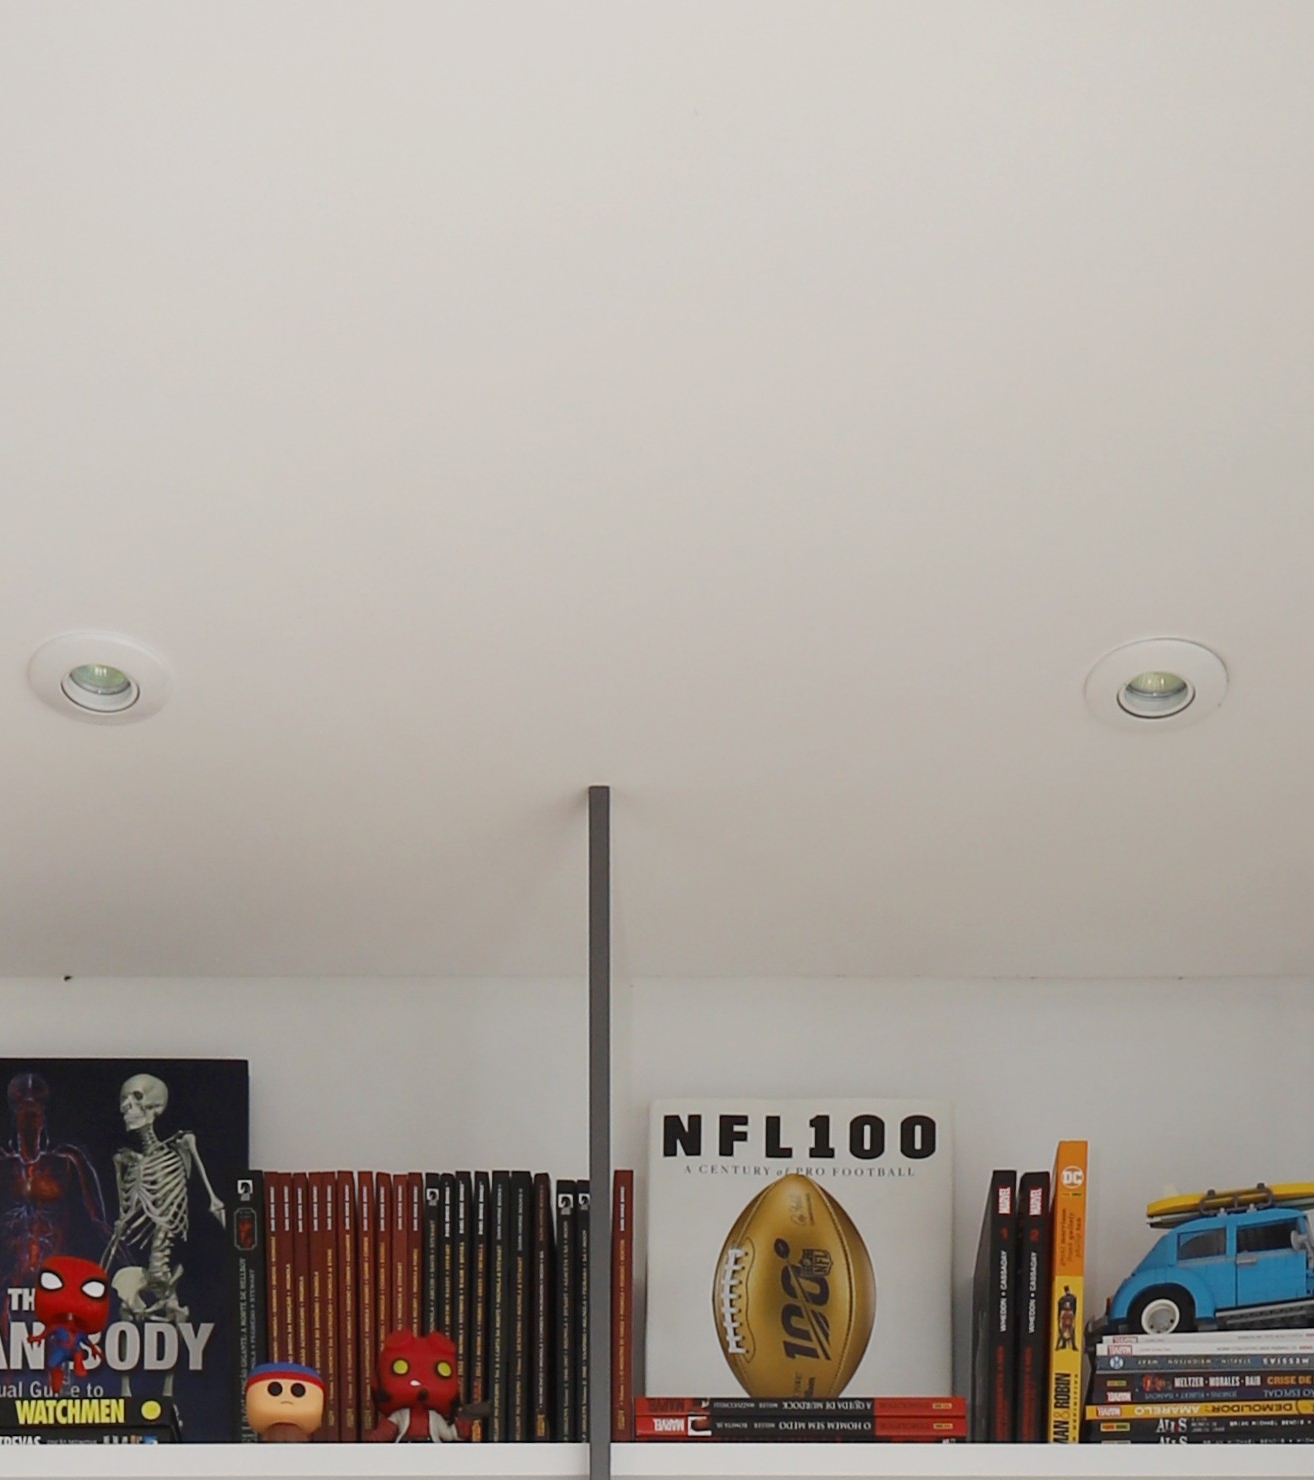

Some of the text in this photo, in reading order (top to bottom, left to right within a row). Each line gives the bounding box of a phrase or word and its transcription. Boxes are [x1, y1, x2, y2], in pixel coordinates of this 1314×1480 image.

[663, 1114, 936, 1160] NFL100
[699, 1165, 771, 1176] CENTURY
[796, 1167, 825, 1177] PRO
[832, 1168, 916, 1178] FOOTBALL
[87, 1382, 105, 1398] to
[15, 1399, 125, 1425] WATCHMEN
